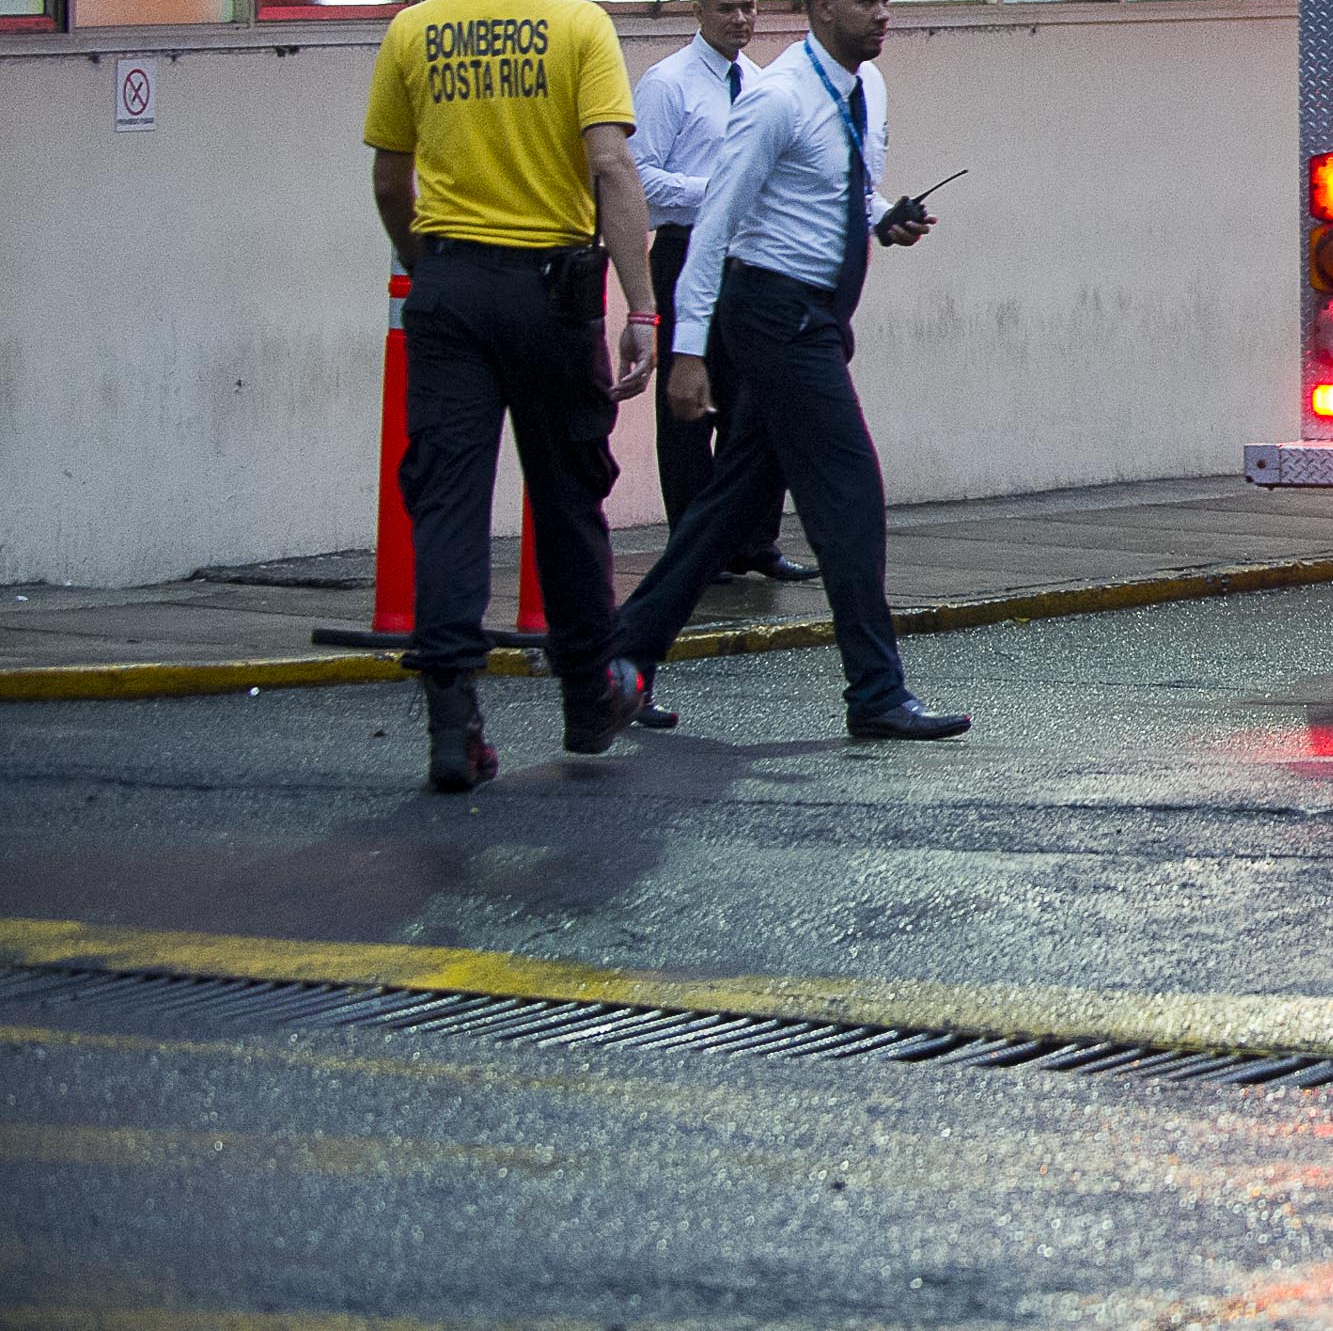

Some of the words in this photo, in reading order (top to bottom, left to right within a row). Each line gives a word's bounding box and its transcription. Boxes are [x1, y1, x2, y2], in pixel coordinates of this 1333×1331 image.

[425, 19, 548, 62] BOMBEROS
[428, 59, 493, 104] COSTA
[500, 58, 548, 98] RICA
